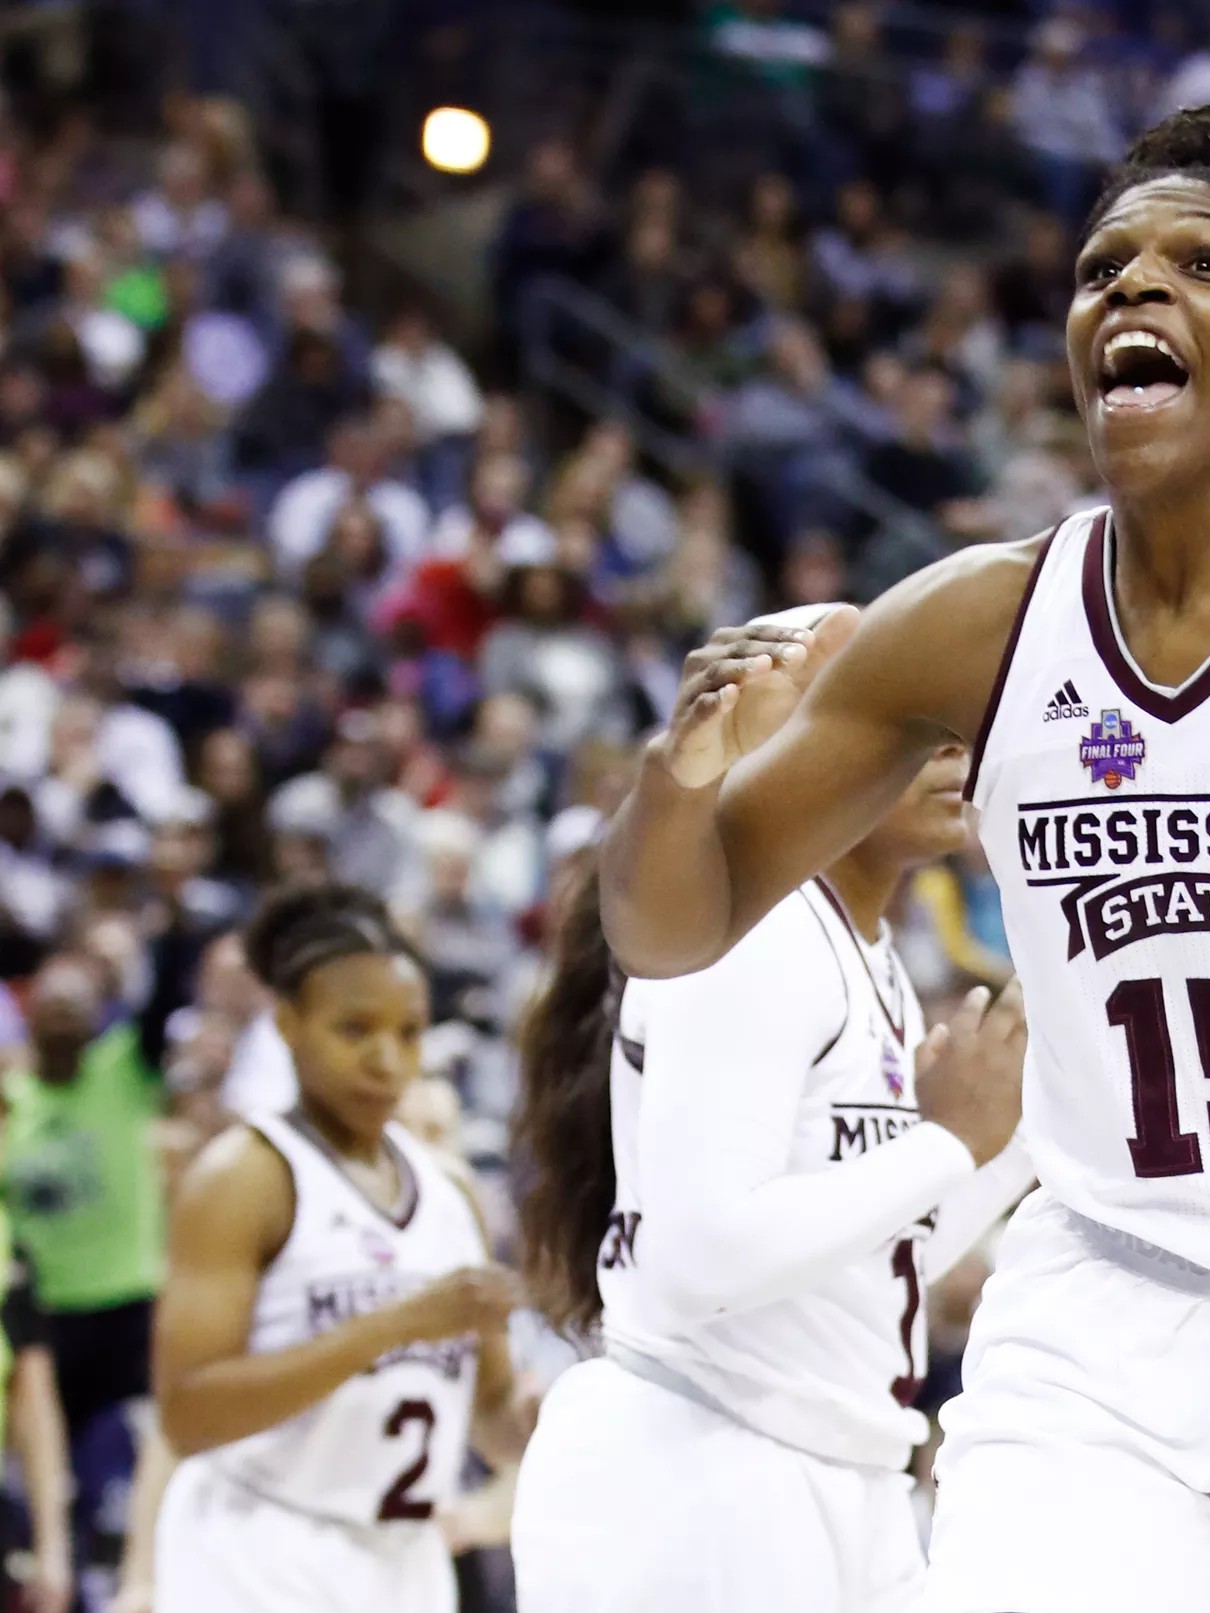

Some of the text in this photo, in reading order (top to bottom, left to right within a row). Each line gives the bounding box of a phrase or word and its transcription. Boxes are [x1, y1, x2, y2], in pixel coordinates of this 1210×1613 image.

[1043, 703, 1090, 721] adidas
[1081, 742, 1144, 760] FINAL FOUR
[377, 1398, 435, 1521] 2
